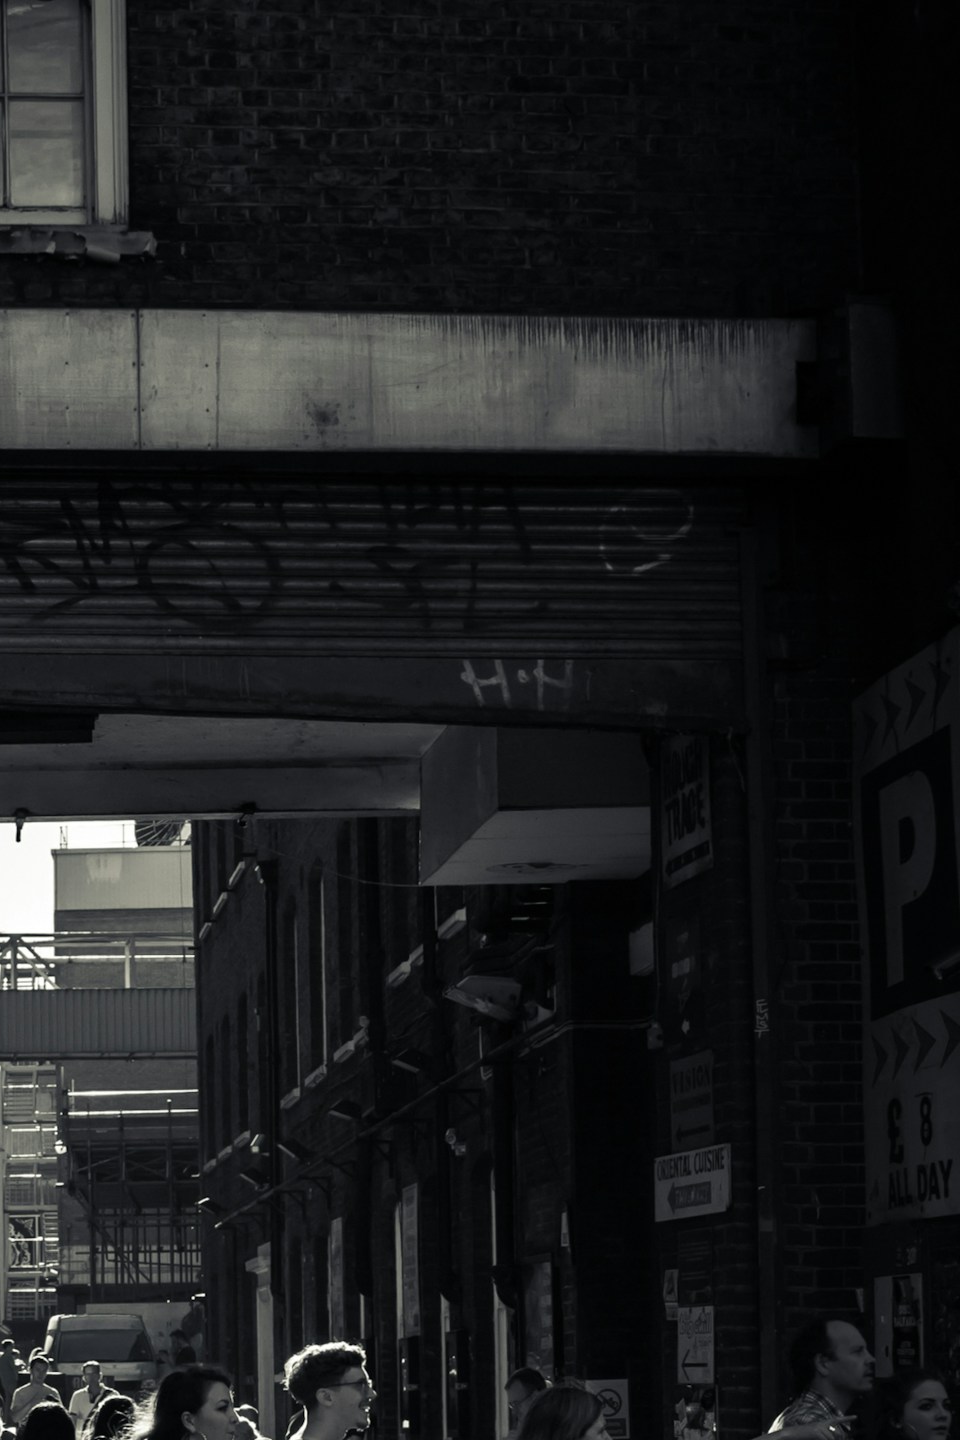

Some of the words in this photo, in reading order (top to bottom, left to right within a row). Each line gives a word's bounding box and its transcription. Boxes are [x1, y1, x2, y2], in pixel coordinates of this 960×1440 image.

[665, 782, 705, 846] TRADE
[878, 768, 936, 989] P
[657, 1154, 691, 1181] ORIENTAL
[694, 1147, 725, 1175] CUISINE
[888, 1167, 913, 1210] ALL
[917, 1158, 953, 1202] DAY
